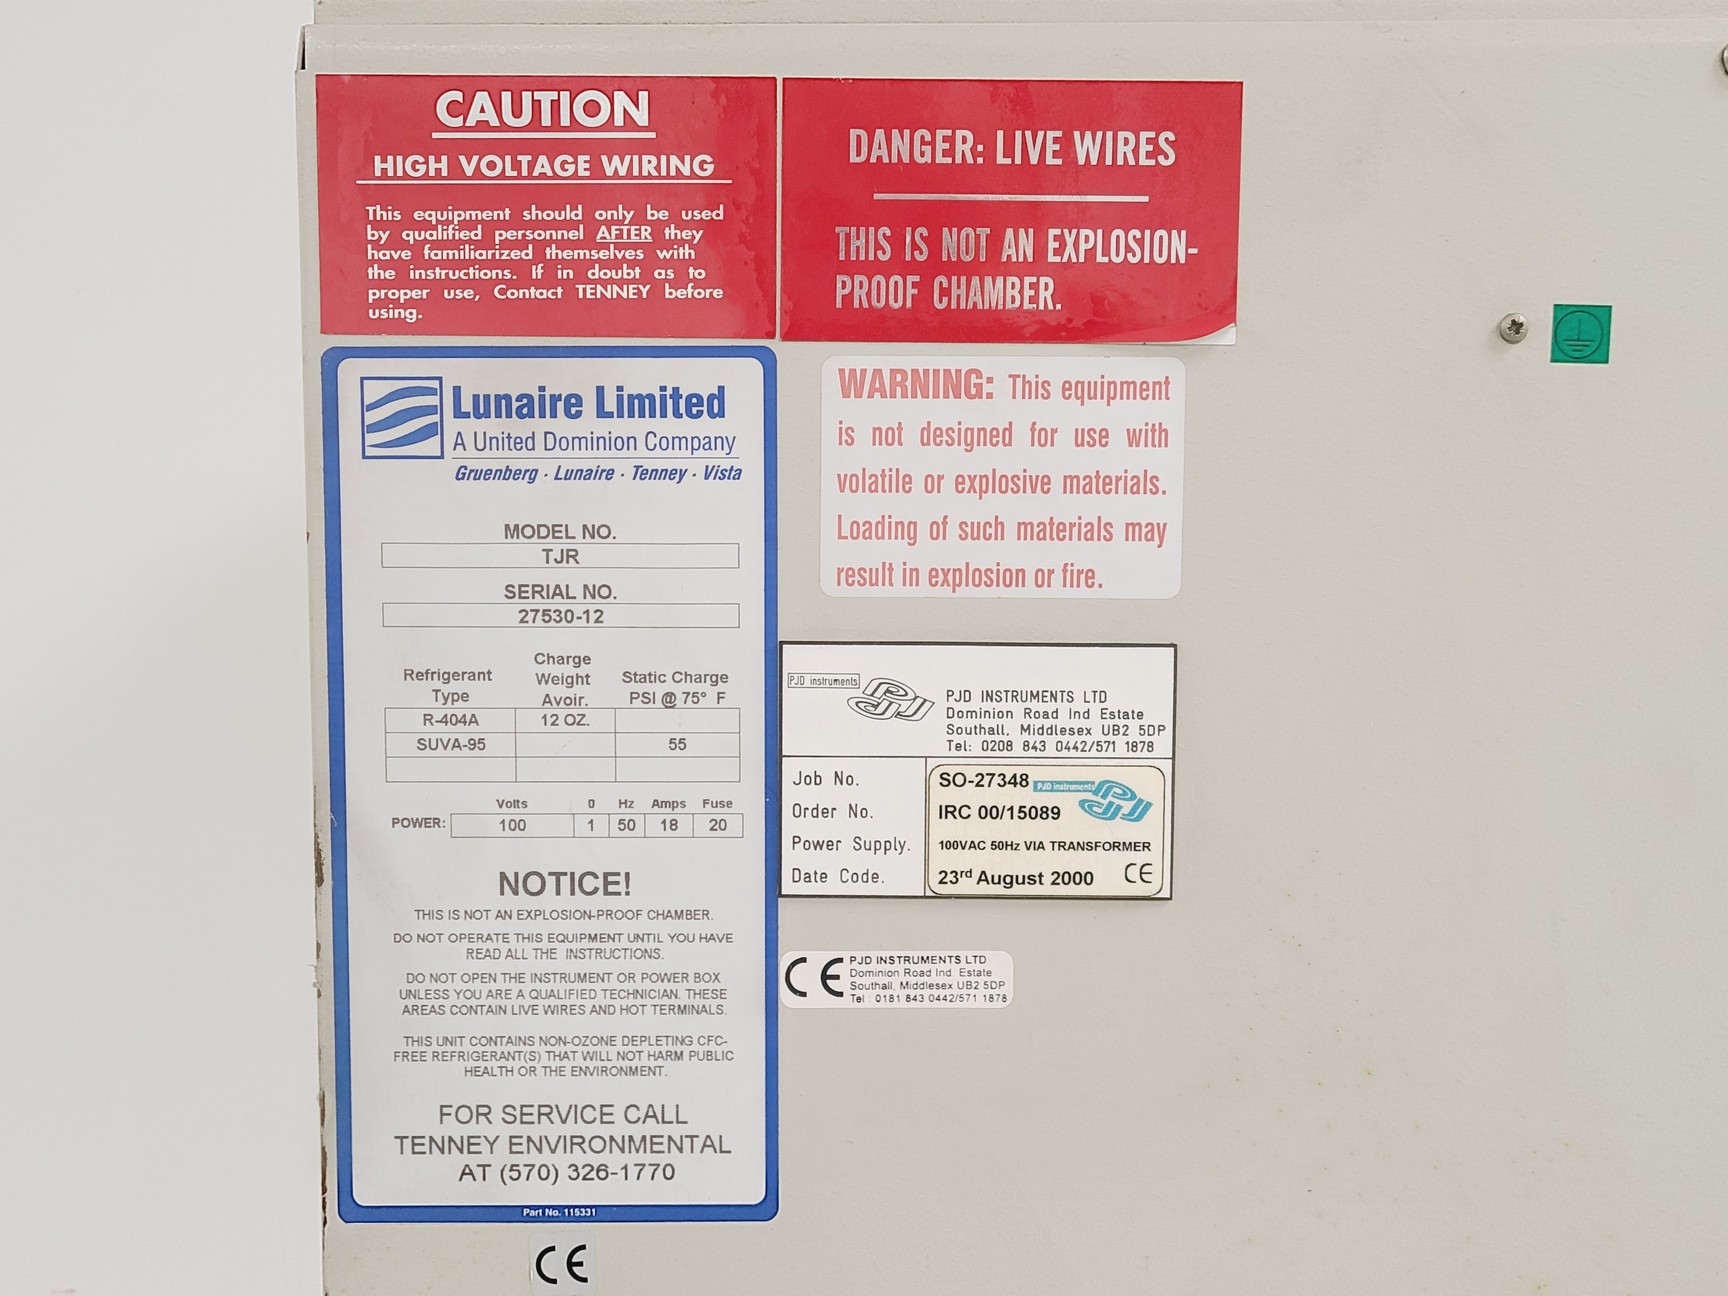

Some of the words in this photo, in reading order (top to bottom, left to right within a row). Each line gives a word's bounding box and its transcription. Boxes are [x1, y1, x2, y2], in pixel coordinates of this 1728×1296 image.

[436, 90, 648, 127] CAUTION
[850, 129, 983, 164] DANGER:
[996, 130, 1062, 165] LIVE
[1073, 131, 1175, 166] WIRES
[374, 155, 448, 177] HIGH
[458, 154, 590, 177] VOLTAGE
[601, 154, 714, 177] WIRING
[367, 224, 390, 244] by
[402, 224, 482, 244] qualified
[495, 224, 583, 244] personnel
[596, 225, 653, 242] AFTER
[664, 224, 703, 244] they
[836, 227, 891, 261] THIS
[905, 227, 928, 261] IS
[942, 227, 990, 261] NOT
[1001, 228, 1033, 262] AN
[1047, 228, 1198, 264] EXPLOSION-
[368, 289, 430, 303] proper
[444, 289, 480, 301] use,
[494, 284, 563, 299] Contact
[575, 284, 651, 299] TENNEY
[665, 283, 723, 299] before
[836, 275, 920, 309] PROOF
[934, 275, 1061, 310] CHAMBER.
[838, 367, 993, 400] WARNING:
[1008, 373, 1051, 400] This
[1061, 374, 1170, 405] equipment
[453, 386, 582, 419] Lunaire
[596, 386, 725, 419] Limited
[453, 431, 467, 451] A
[474, 431, 535, 452] United
[544, 431, 637, 451] Dominion
[645, 431, 736, 455] Company
[455, 465, 539, 484] Gruenberg
[554, 465, 615, 481] Lunaire
[632, 465, 688, 484] Tenney
[704, 465, 742, 480] Vista
[504, 524, 576, 539] MODEL
[582, 524, 616, 540] NO.
[837, 513, 918, 547] Loading
[929, 515, 948, 542] of
[958, 514, 1005, 542] such
[1016, 515, 1114, 543] materials
[1124, 521, 1167, 548] may
[542, 548, 580, 564] TJR
[504, 584, 577, 600] SERIAL
[583, 584, 617, 600] NO.
[518, 609, 604, 624] 27530-12
[534, 653, 591, 668] Charge
[404, 669, 492, 684] Refrigerant
[535, 673, 591, 689] Weight
[622, 671, 666, 683] Static
[672, 671, 729, 686] Charge
[790, 675, 805, 686] PJD
[810, 677, 858, 686] instruments
[432, 689, 469, 705] Type
[542, 693, 588, 706] Avoir.
[630, 691, 656, 704] PSI
[661, 691, 677, 708] @
[717, 692, 726, 704] F
[946, 689, 971, 703] PJD
[981, 690, 1074, 703] INSTRUMENTS
[1084, 690, 1107, 703] LTD
[423, 713, 479, 726] R-404A
[541, 713, 559, 726] 12
[564, 713, 590, 726] OZ.
[946, 707, 1013, 719] Dominion
[1024, 707, 1058, 719] Road
[1069, 708, 1090, 720] Ind
[1100, 708, 1144, 720] Estate
[1020, 724, 1092, 736] Middlesex
[1102, 724, 1129, 736] UB2
[1139, 724, 1166, 736] 5DP
[417, 738, 486, 751] SUVA-95
[669, 738, 687, 751] 55
[793, 770, 822, 786] Job
[834, 771, 859, 786] No.
[939, 772, 1029, 788] SO-27348
[496, 799, 528, 809] Volts
[618, 799, 634, 809] Hz
[651, 799, 686, 811] Amps
[703, 799, 733, 808] Fuse
[793, 803, 837, 818] Order
[849, 803, 873, 819] No.
[939, 804, 971, 819] IRC
[978, 805, 1061, 820] 00/15089
[392, 817, 445, 828] POWER:
[500, 819, 526, 832] 100
[588, 819, 593, 832] 1
[618, 819, 636, 831] 50
[661, 818, 678, 831] 18
[709, 818, 727, 831] 20
[792, 835, 842, 851] Power
[853, 836, 910, 855] Supply.
[939, 840, 986, 850] 100VAC
[990, 841, 1020, 851] 50Hz
[1024, 841, 1045, 851] VIA
[1049, 841, 1151, 852] TRANSFORMER
[792, 868, 828, 883] Date
[840, 868, 884, 883] Code.
[976, 870, 1044, 889] August
[1050, 871, 1094, 886] 2000
[499, 871, 630, 897] NOTICE!
[414, 909, 443, 920] THIS
[448, 909, 460, 920] IS
[464, 909, 492, 920] NOT
[495, 909, 512, 920] AN
[517, 909, 643, 920] EXPLOSION-PROOF
[647, 909, 713, 920] CHAMBER.
[393, 933, 413, 943] DO
[417, 933, 444, 943] NOT
[448, 933, 510, 944] OPERATE
[513, 933, 543, 943] THIS
[548, 933, 624, 943] EQUIPMENT
[627, 933, 663, 943] UNTIL
[668, 933, 695, 943] YOU
[699, 933, 733, 943] HAVE
[850, 956, 872, 965] PJD
[876, 955, 961, 965] INSTRUMENTS
[966, 955, 986, 964] LTD
[402, 1004, 446, 1016] AREAS
[450, 1004, 507, 1016] CONTAIN
[511, 1004, 539, 1015] LIVE
[543, 1004, 586, 1015] WIRES
[589, 1004, 616, 1015] AND
[620, 1004, 647, 1015] HOT
[650, 1004, 727, 1015] TERMINALS.
[403, 1036, 432, 1047] THIS
[436, 1036, 466, 1047] UNIT
[469, 1036, 535, 1047] CONTAINS
[539, 1035, 617, 1047] NON-OZONE
[622, 1035, 693, 1046] DEPLETING
[697, 1035, 728, 1046] CFC-
[440, 1104, 493, 1125] FOR
[501, 1104, 615, 1125] SERVICE
[624, 1104, 688, 1124] CALL
[394, 1135, 500, 1155] TENNEY
[509, 1135, 732, 1154] ENVIRONMENTAL
[458, 1164, 492, 1182] AT
[500, 1164, 559, 1186] (570)
[568, 1163, 675, 1181] 326-1770
[523, 1208, 542, 1216] Part
[545, 1208, 561, 1216] No.
[564, 1208, 595, 1216] 115331
